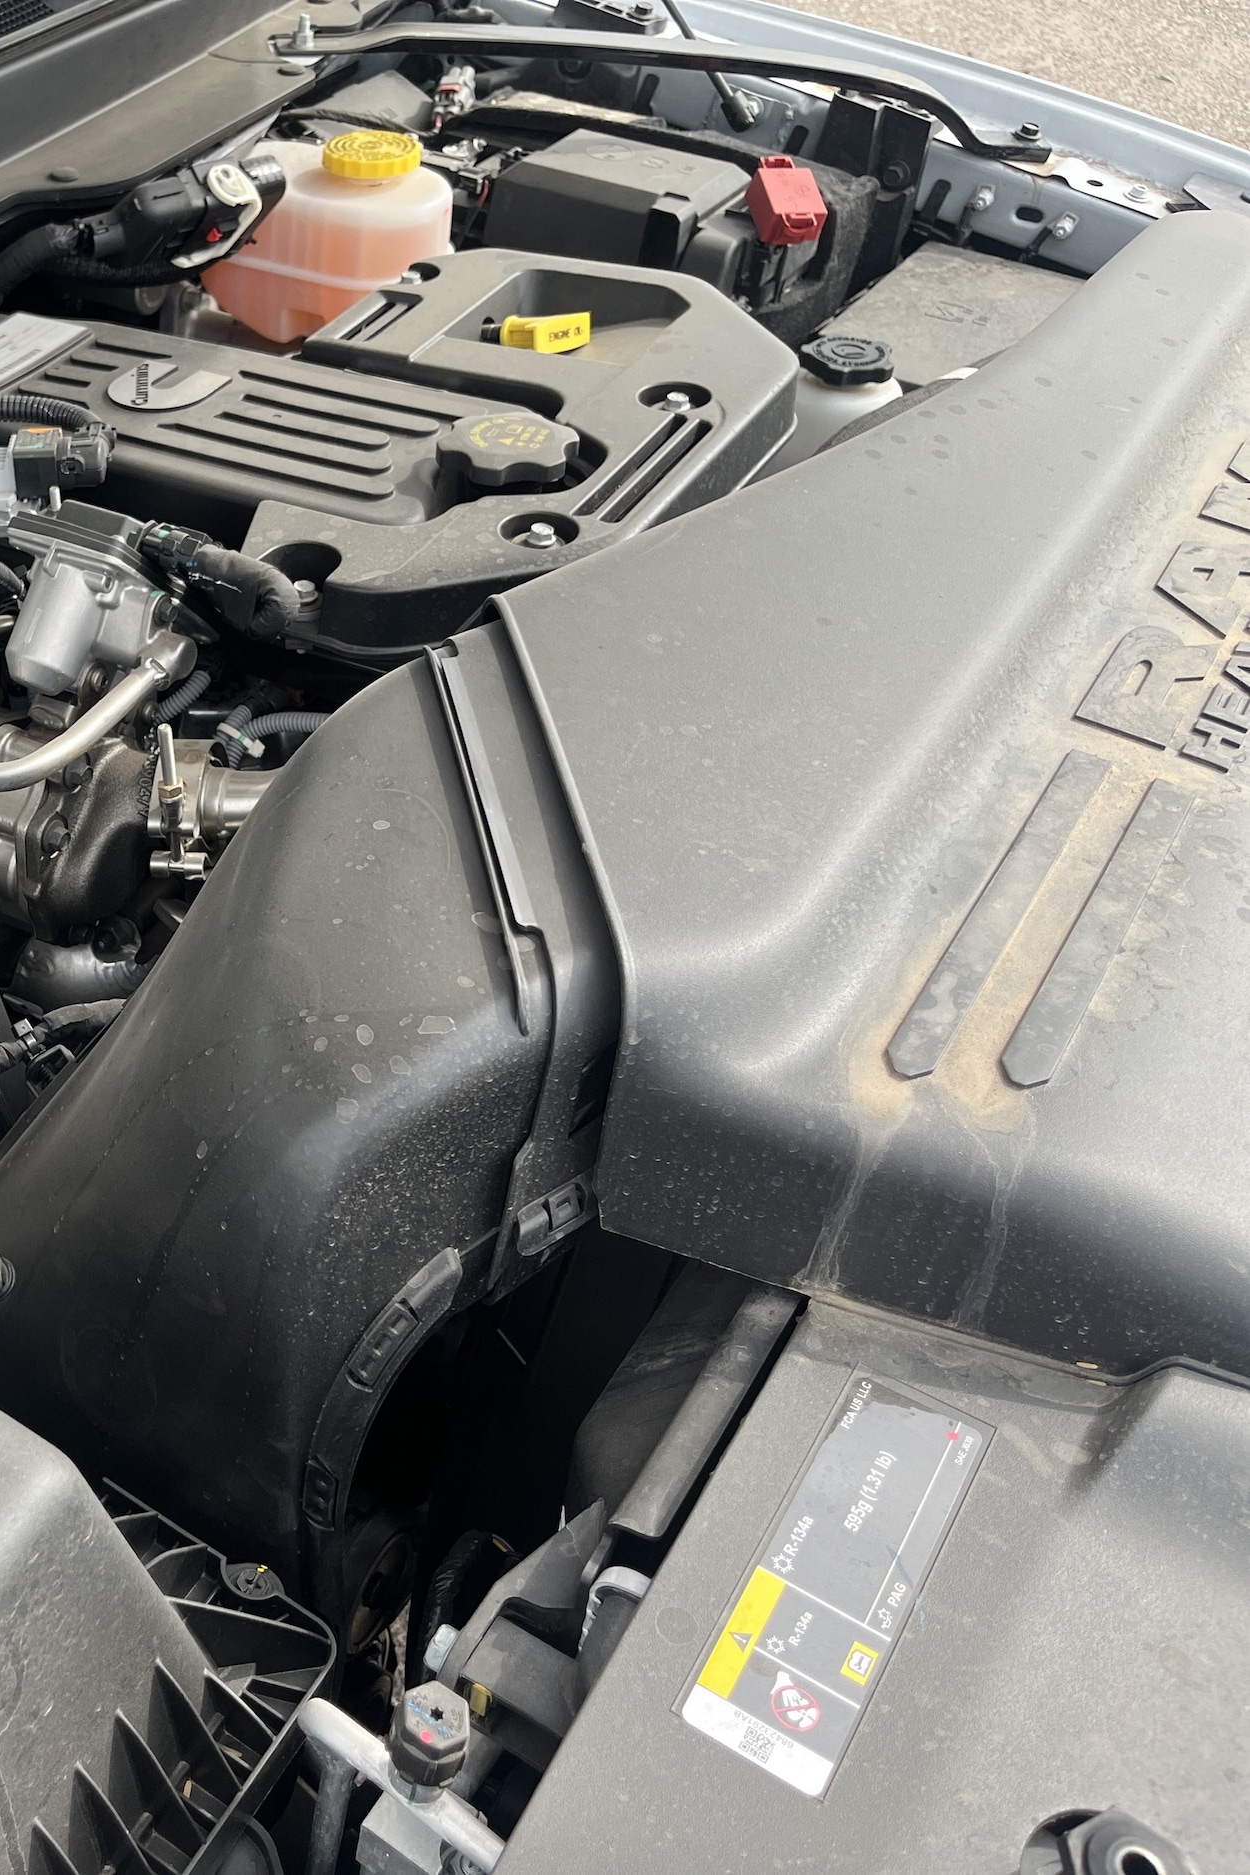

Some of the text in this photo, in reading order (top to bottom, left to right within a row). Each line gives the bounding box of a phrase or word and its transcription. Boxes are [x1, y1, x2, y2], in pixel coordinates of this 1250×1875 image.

[548, 329, 570, 342] ENGINE
[840, 1381, 872, 1430] FCA US LLC
[954, 1450, 967, 1466] SAE
[844, 1450, 898, 1532] 595g (1.31 lb)
[782, 1515, 814, 1556] R-134a
[886, 1581, 907, 1608] PAG
[788, 1611, 813, 1646] R-134a
